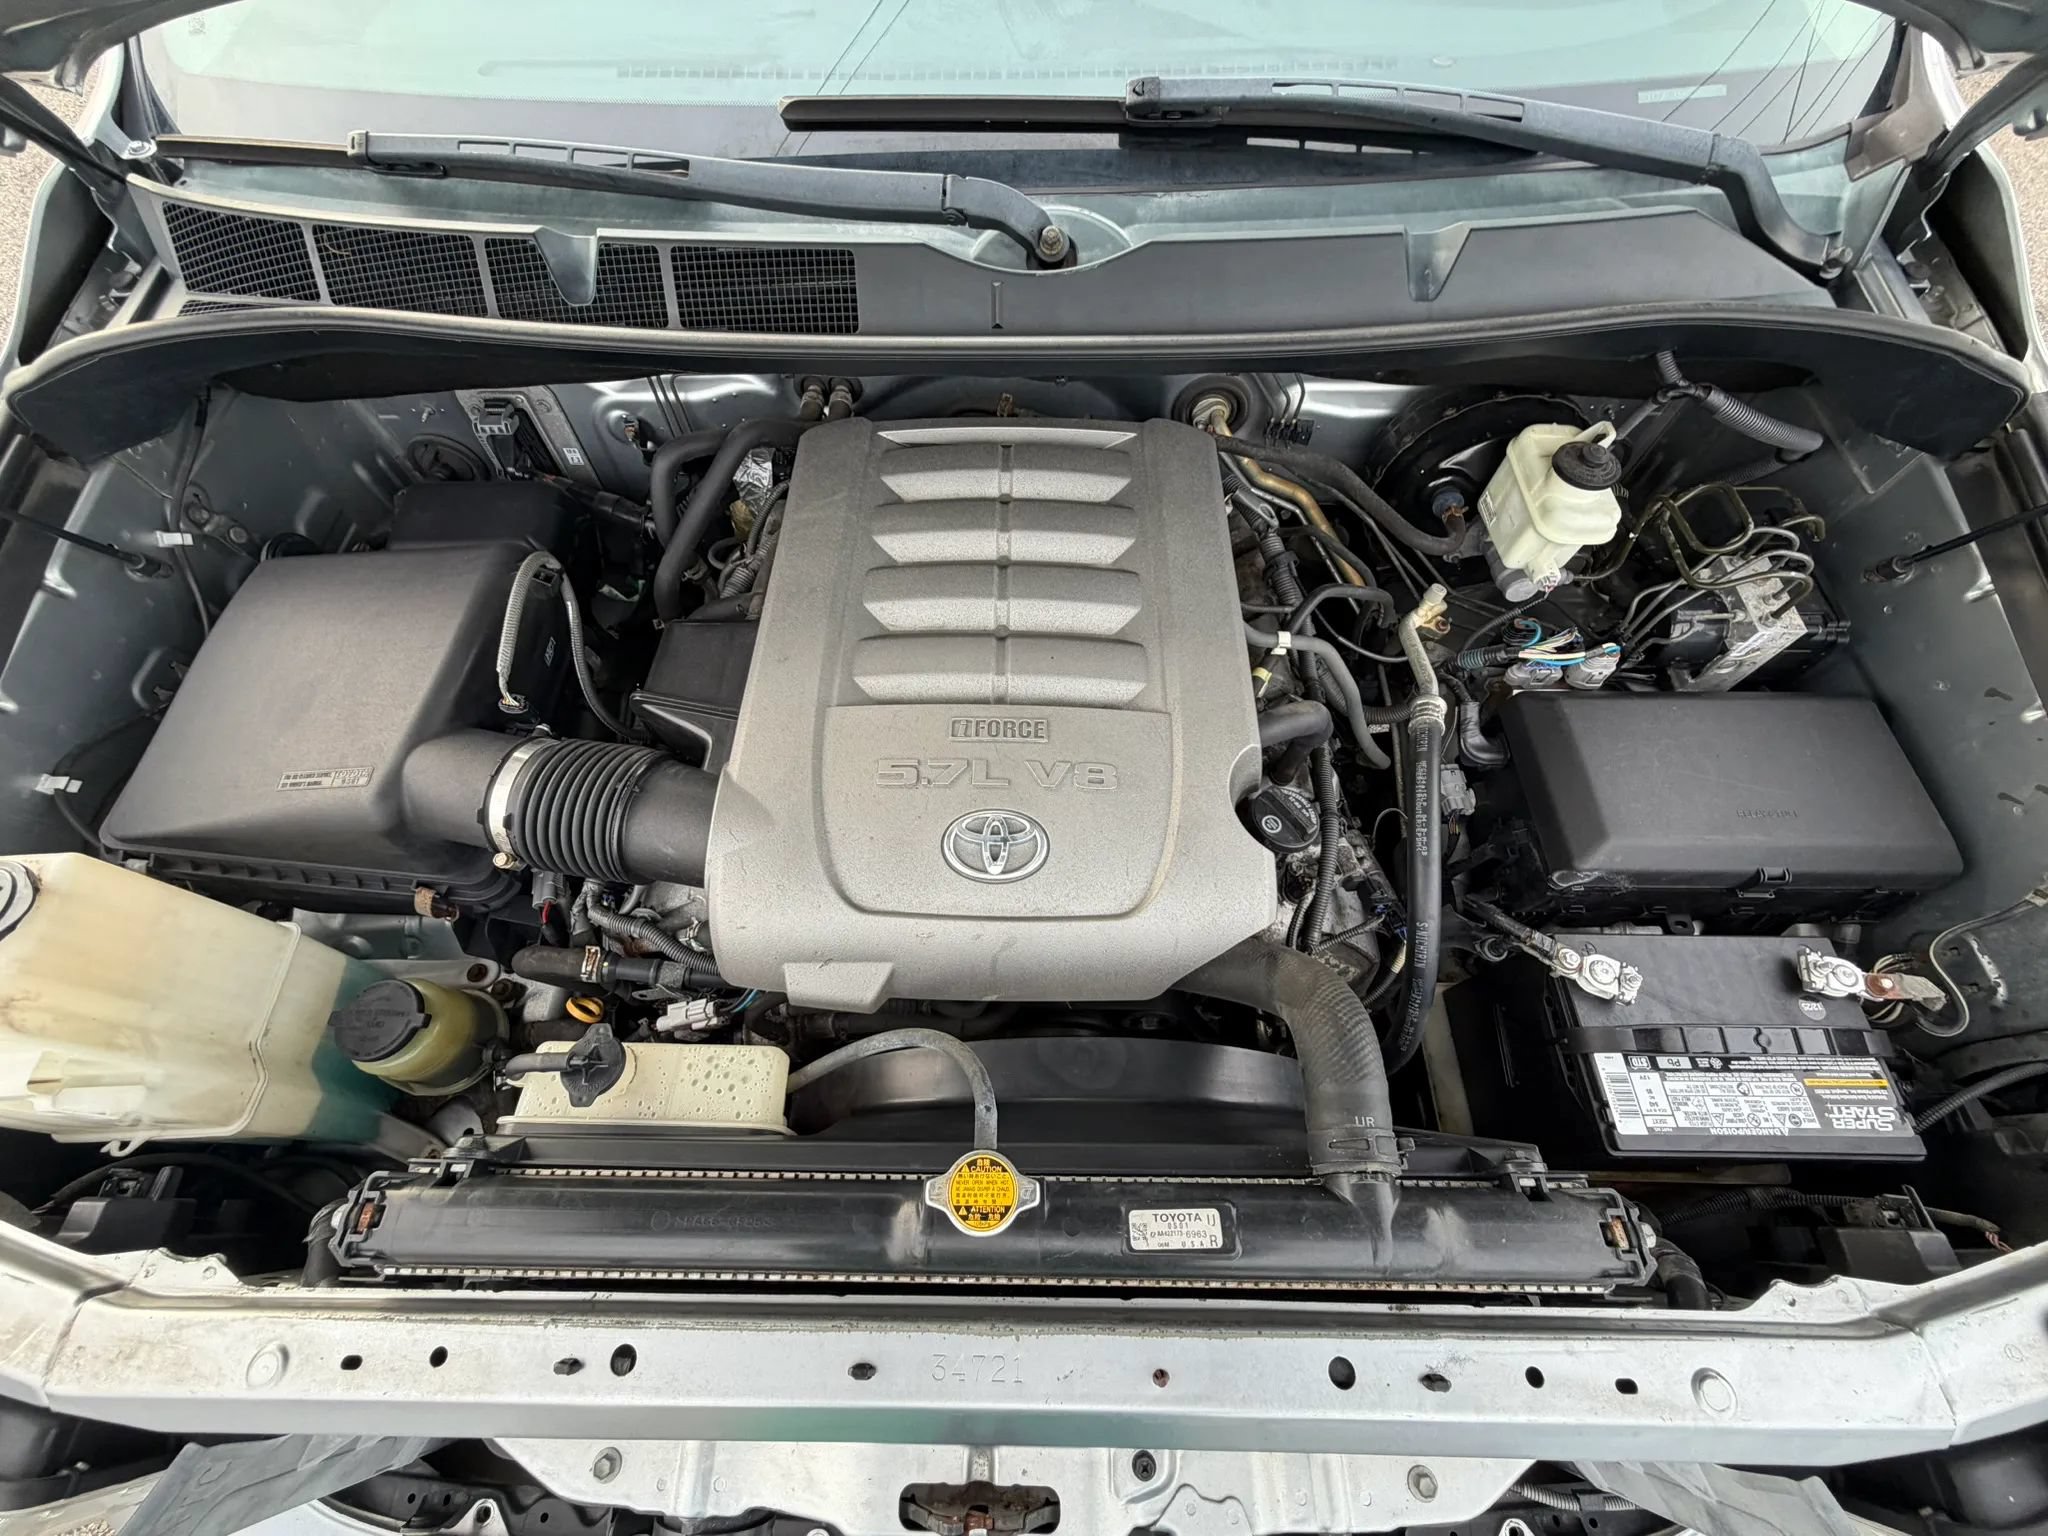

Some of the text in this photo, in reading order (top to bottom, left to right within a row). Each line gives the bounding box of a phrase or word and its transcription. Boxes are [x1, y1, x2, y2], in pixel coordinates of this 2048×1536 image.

[876, 757, 1119, 791] 5.7L V8
[1667, 1058, 1681, 1067] Pb
[1829, 1106, 1896, 1120] START
[1354, 1115, 1375, 1128] UR
[1832, 1118, 1894, 1132] SUPER
[1710, 1127, 1781, 1136] DANGER/POISON
[1152, 1212, 1202, 1222] TOYOTA
[1209, 1234, 1219, 1247] R
[931, 1353, 1024, 1384] 34721
